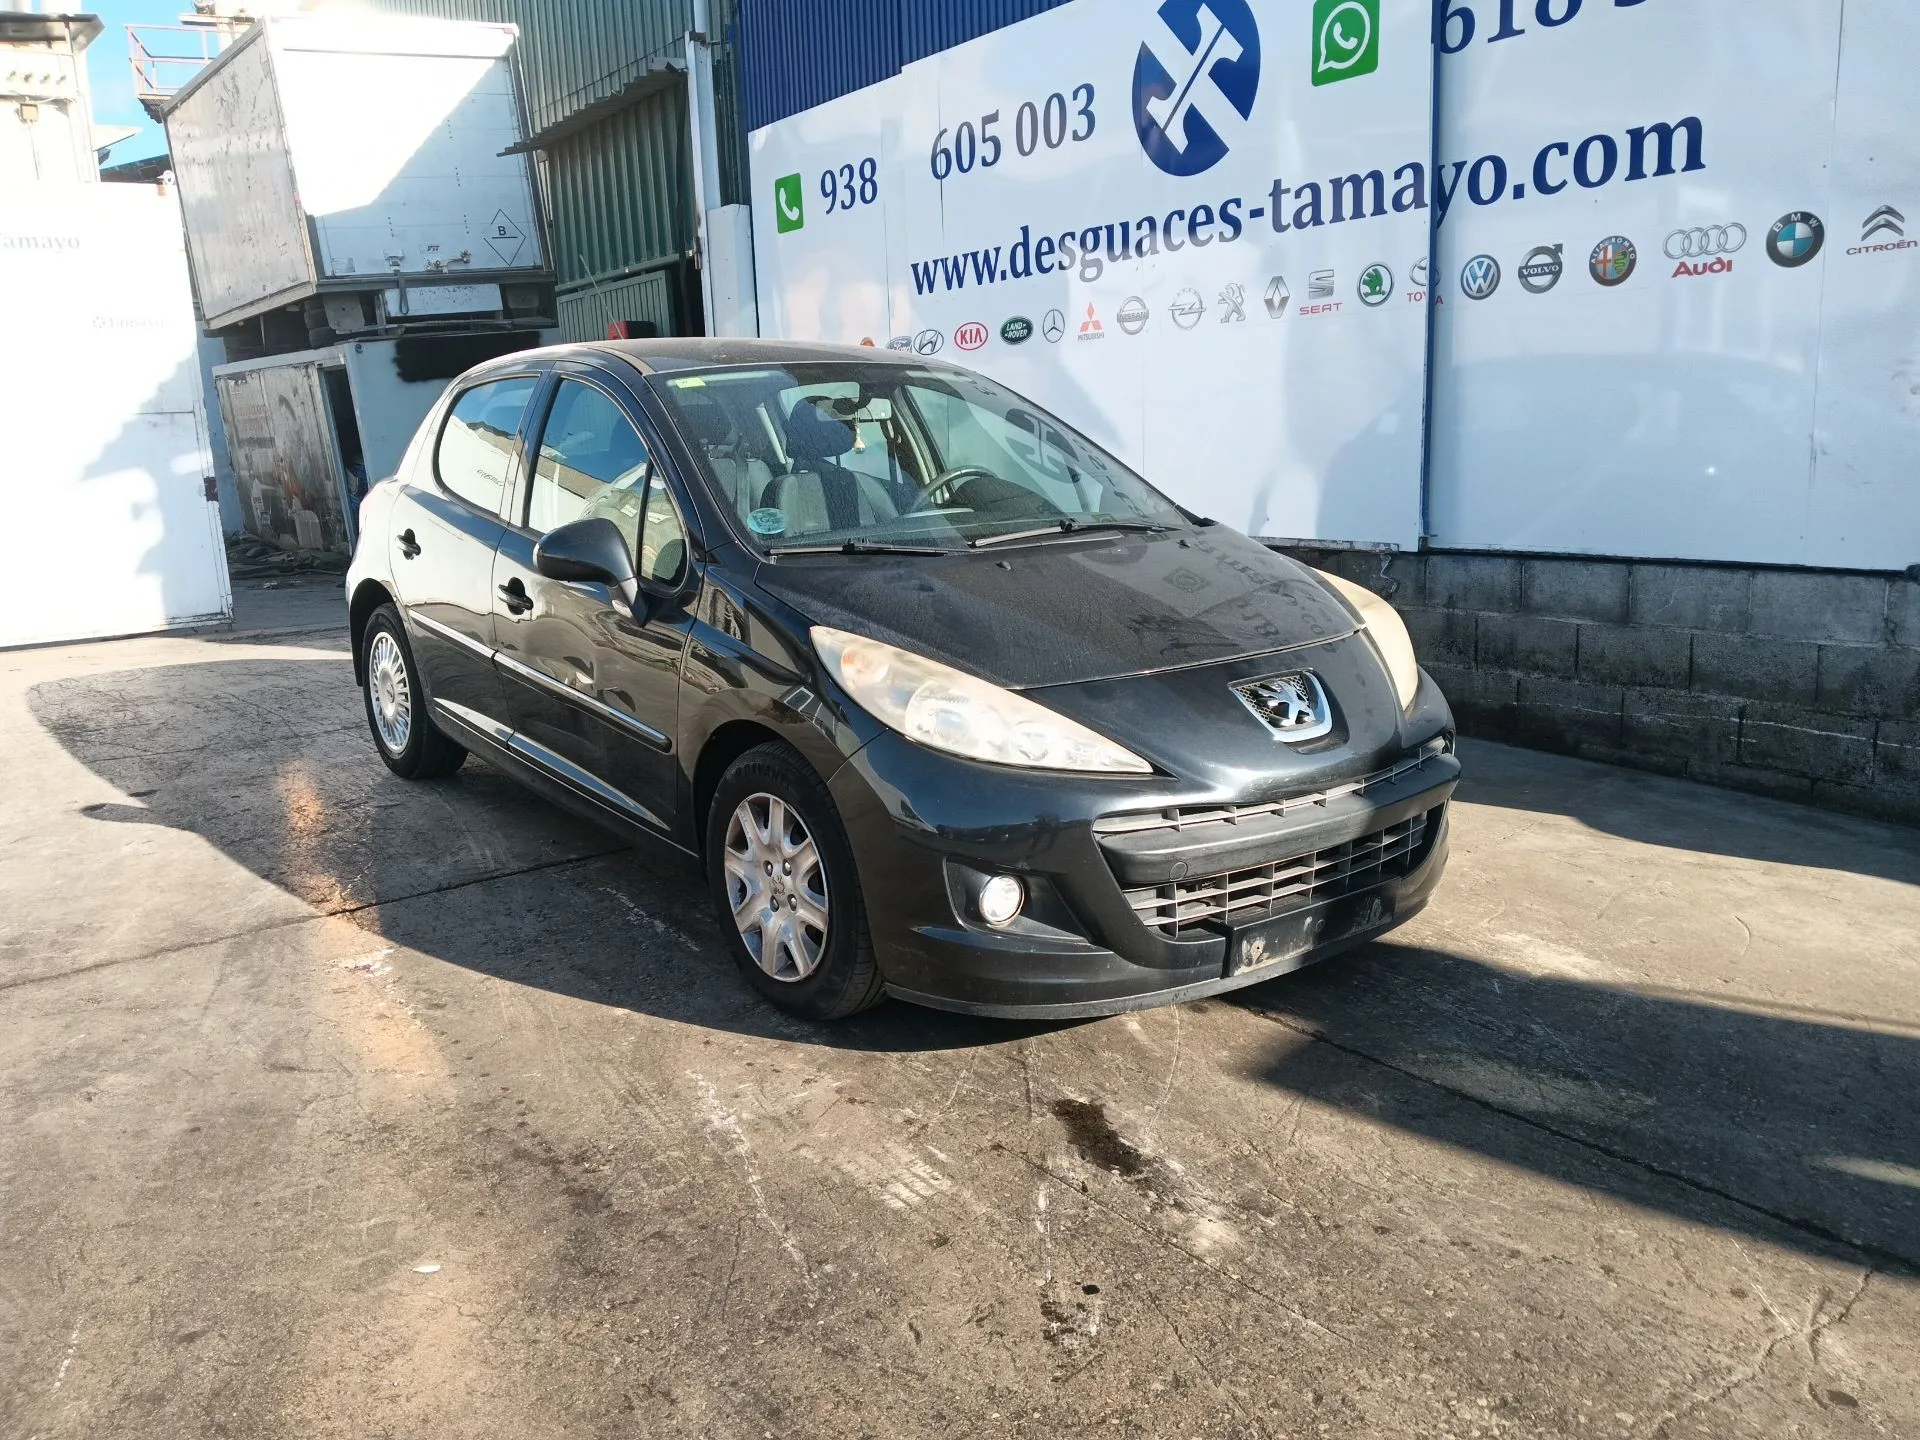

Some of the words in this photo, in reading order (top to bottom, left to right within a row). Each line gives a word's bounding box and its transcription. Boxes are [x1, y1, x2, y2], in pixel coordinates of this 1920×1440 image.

[820, 157, 879, 215] 938
[930, 109, 1001, 180] 605
[1015, 83, 1097, 157] 003
[910, 115, 1706, 296] www.desguaces-tamayo.com
[0, 232, 80, 253] amayo
[1521, 264, 1559, 275] VOLVO
[1671, 257, 1733, 278] Audi
[1119, 311, 1147, 321] NISSAN
[1300, 302, 1343, 316] SEAT
[960, 327, 982, 345] KIA
[1078, 332, 1105, 342] MITSUBISHI
